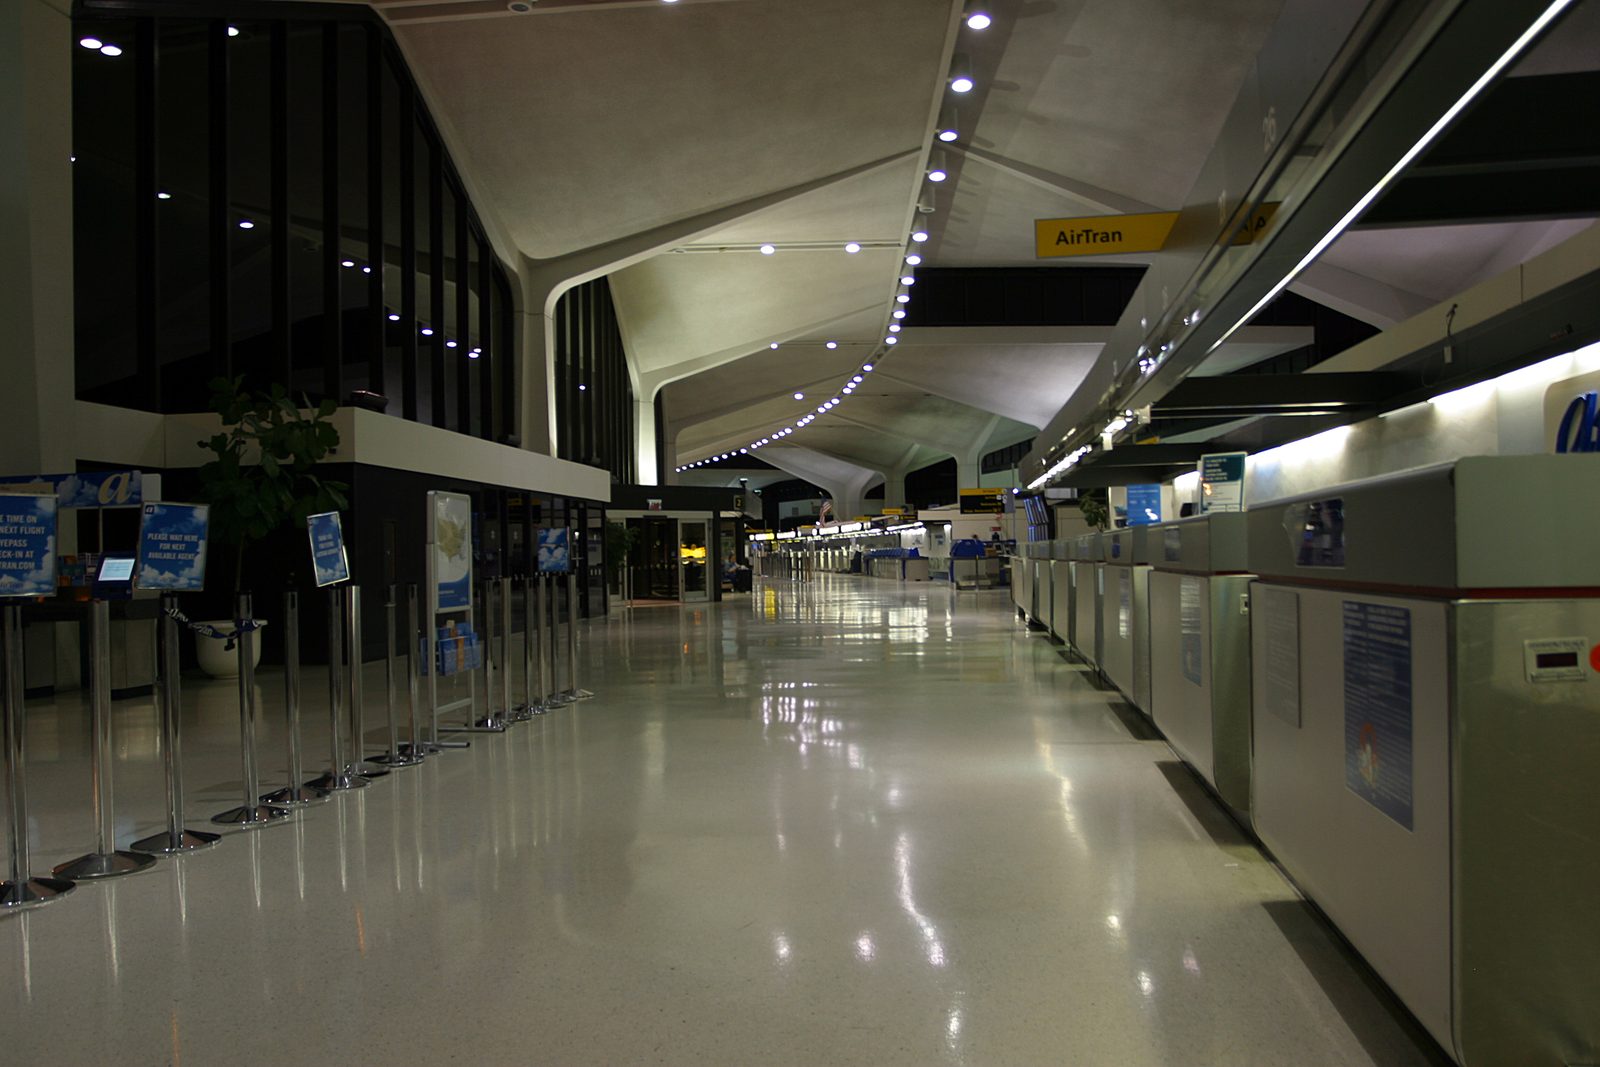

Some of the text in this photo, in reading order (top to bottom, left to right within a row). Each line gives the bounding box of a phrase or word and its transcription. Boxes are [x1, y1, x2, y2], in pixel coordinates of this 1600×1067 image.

[1056, 228, 1122, 245] AirTran
[6, 515, 25, 523] TIME
[26, 516, 38, 524] ON
[20, 527, 45, 535] FLIGHT
